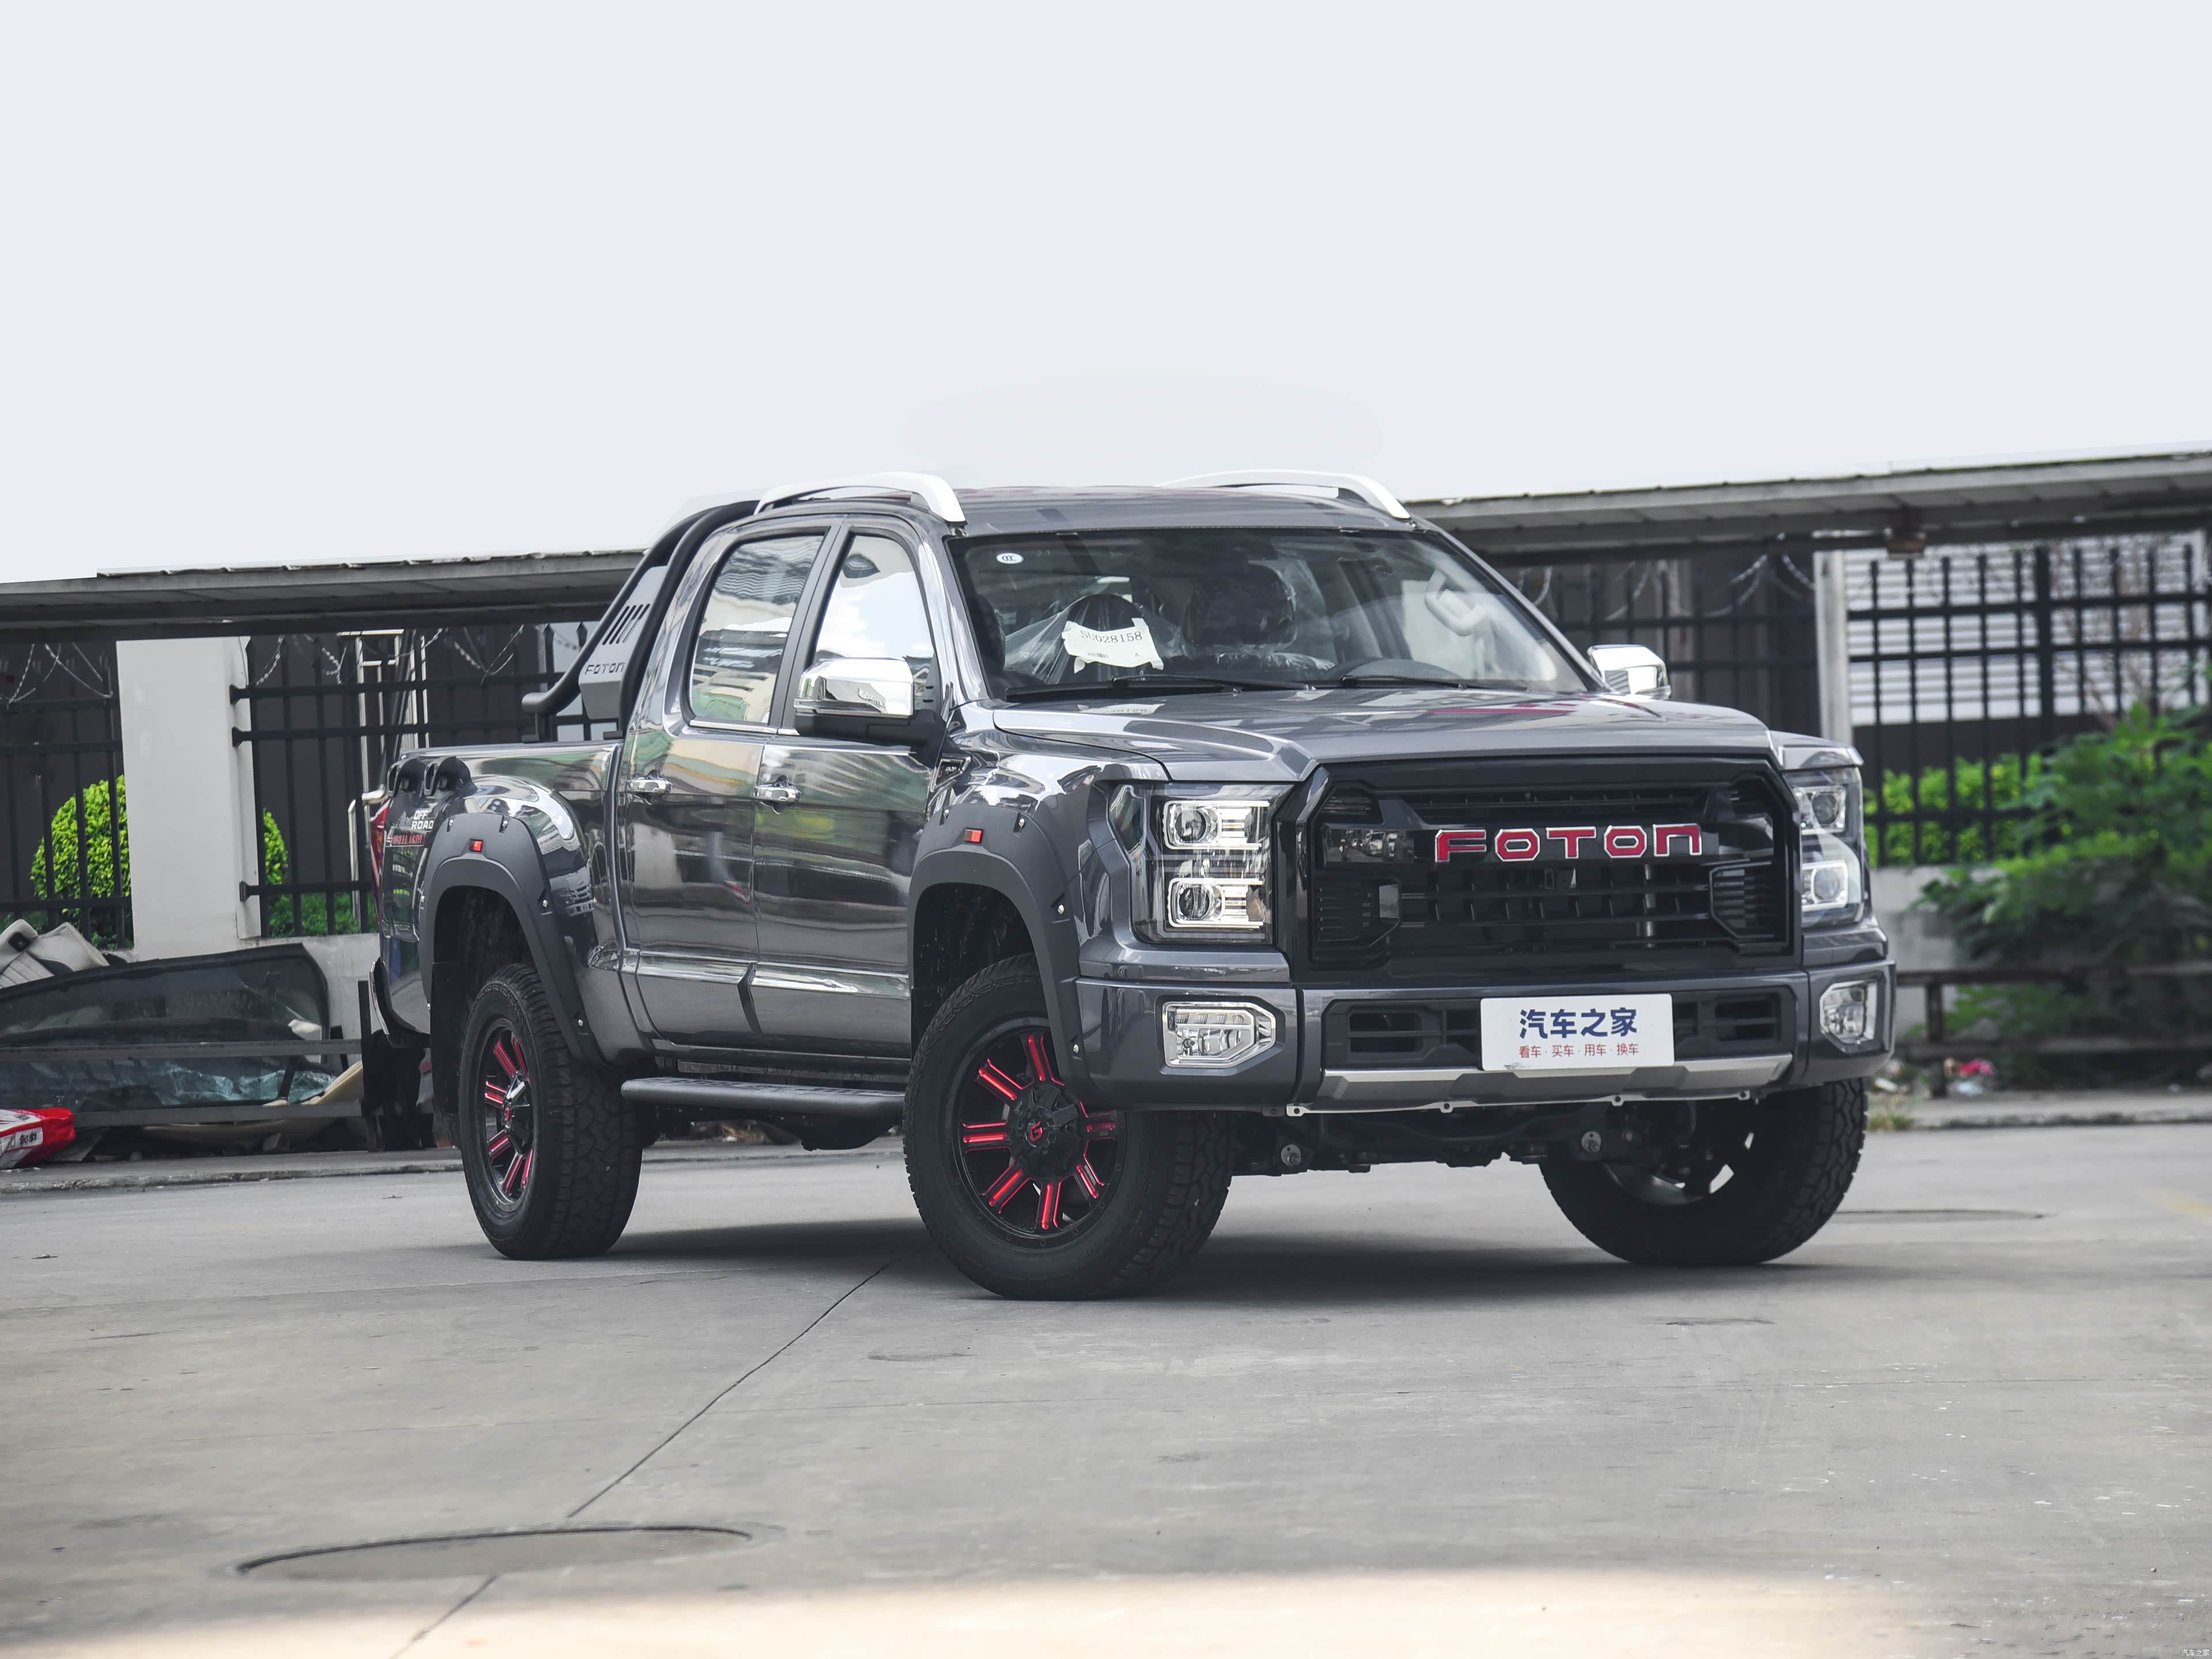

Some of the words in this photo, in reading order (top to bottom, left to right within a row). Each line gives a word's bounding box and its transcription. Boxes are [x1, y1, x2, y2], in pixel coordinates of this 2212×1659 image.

[585, 662, 625, 675] FOTON
[413, 809, 429, 820] OFF
[411, 820, 434, 830] ROAD
[1434, 823, 1702, 862] FOTON
[1519, 1007, 1637, 1039] 汽车之家
